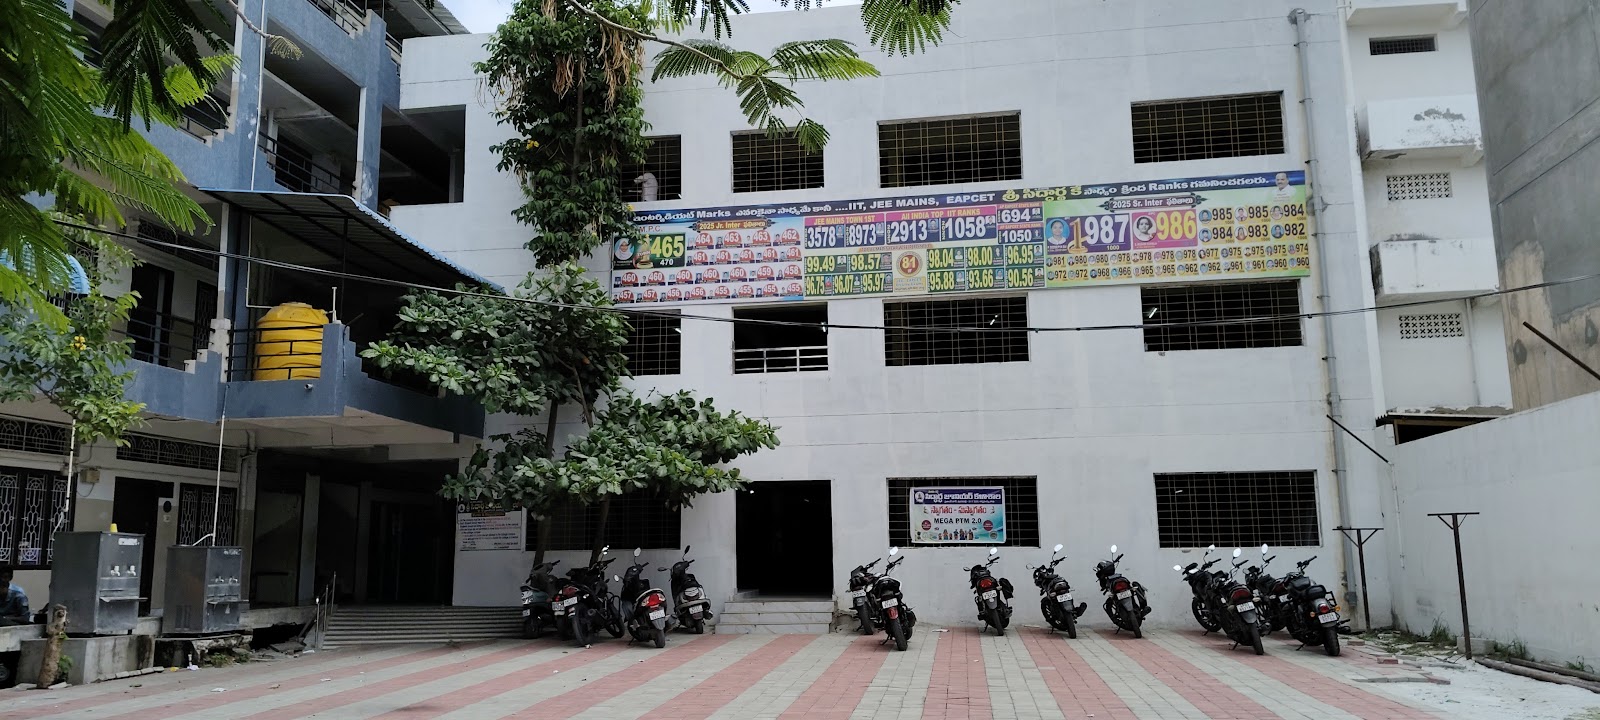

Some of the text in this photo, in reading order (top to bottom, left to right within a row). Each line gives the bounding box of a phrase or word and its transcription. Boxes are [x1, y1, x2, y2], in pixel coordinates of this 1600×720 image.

[696, 210, 731, 218] Marks
[870, 200, 893, 209] JEE
[896, 198, 939, 207] MAINS,
[946, 194, 996, 204] EAPCET
[1002, 188, 1020, 202] శ్రీ
[1149, 182, 1188, 191] Ranks
[1112, 200, 1132, 208] 2025
[1132, 199, 1143, 207] Sr.
[1144, 198, 1162, 206] Inter
[958, 208, 980, 216] RANKS
[1002, 208, 1030, 222] 694
[1212, 204, 1304, 220] 985 985 984
[890, 220, 928, 242] 2913
[946, 216, 986, 238] 1058
[1084, 214, 1129, 244] 987
[1156, 210, 1196, 240] 986
[1212, 223, 1305, 240] 984 983 982
[725, 233, 739, 242] 463
[754, 232, 768, 240] 463
[782, 230, 796, 240] 462
[807, 226, 836, 248] 3578
[848, 224, 876, 246] 8973
[1002, 229, 1032, 242] 1050
[650, 236, 684, 258] 465
[694, 248, 798, 260] 461 461 461 461 461
[1054, 244, 1308, 266] 981 980 980 978 978 978 978 977 975 975 975 974
[807, 256, 835, 273] 99.49
[851, 254, 881, 271] 98.57
[928, 248, 954, 269] 98.04
[968, 246, 992, 268] 98.00
[1007, 244, 1034, 267] 96.95
[902, 256, 916, 268] 81
[1054, 257, 1309, 279] 972 972 968 966 965 965 962 962 961 961 960 960
[622, 266, 798, 282] 460 460 460 460 460 459 458
[806, 275, 824, 296] 96.75
[834, 274, 854, 294] 96.07
[862, 273, 884, 292] 95.97
[930, 272, 954, 291] 95.88
[968, 269, 994, 288] 93.66
[1008, 268, 1034, 288] 90.56
[620, 292, 632, 300] 457
[691, 288, 704, 296] 456
[738, 286, 752, 294] 455
